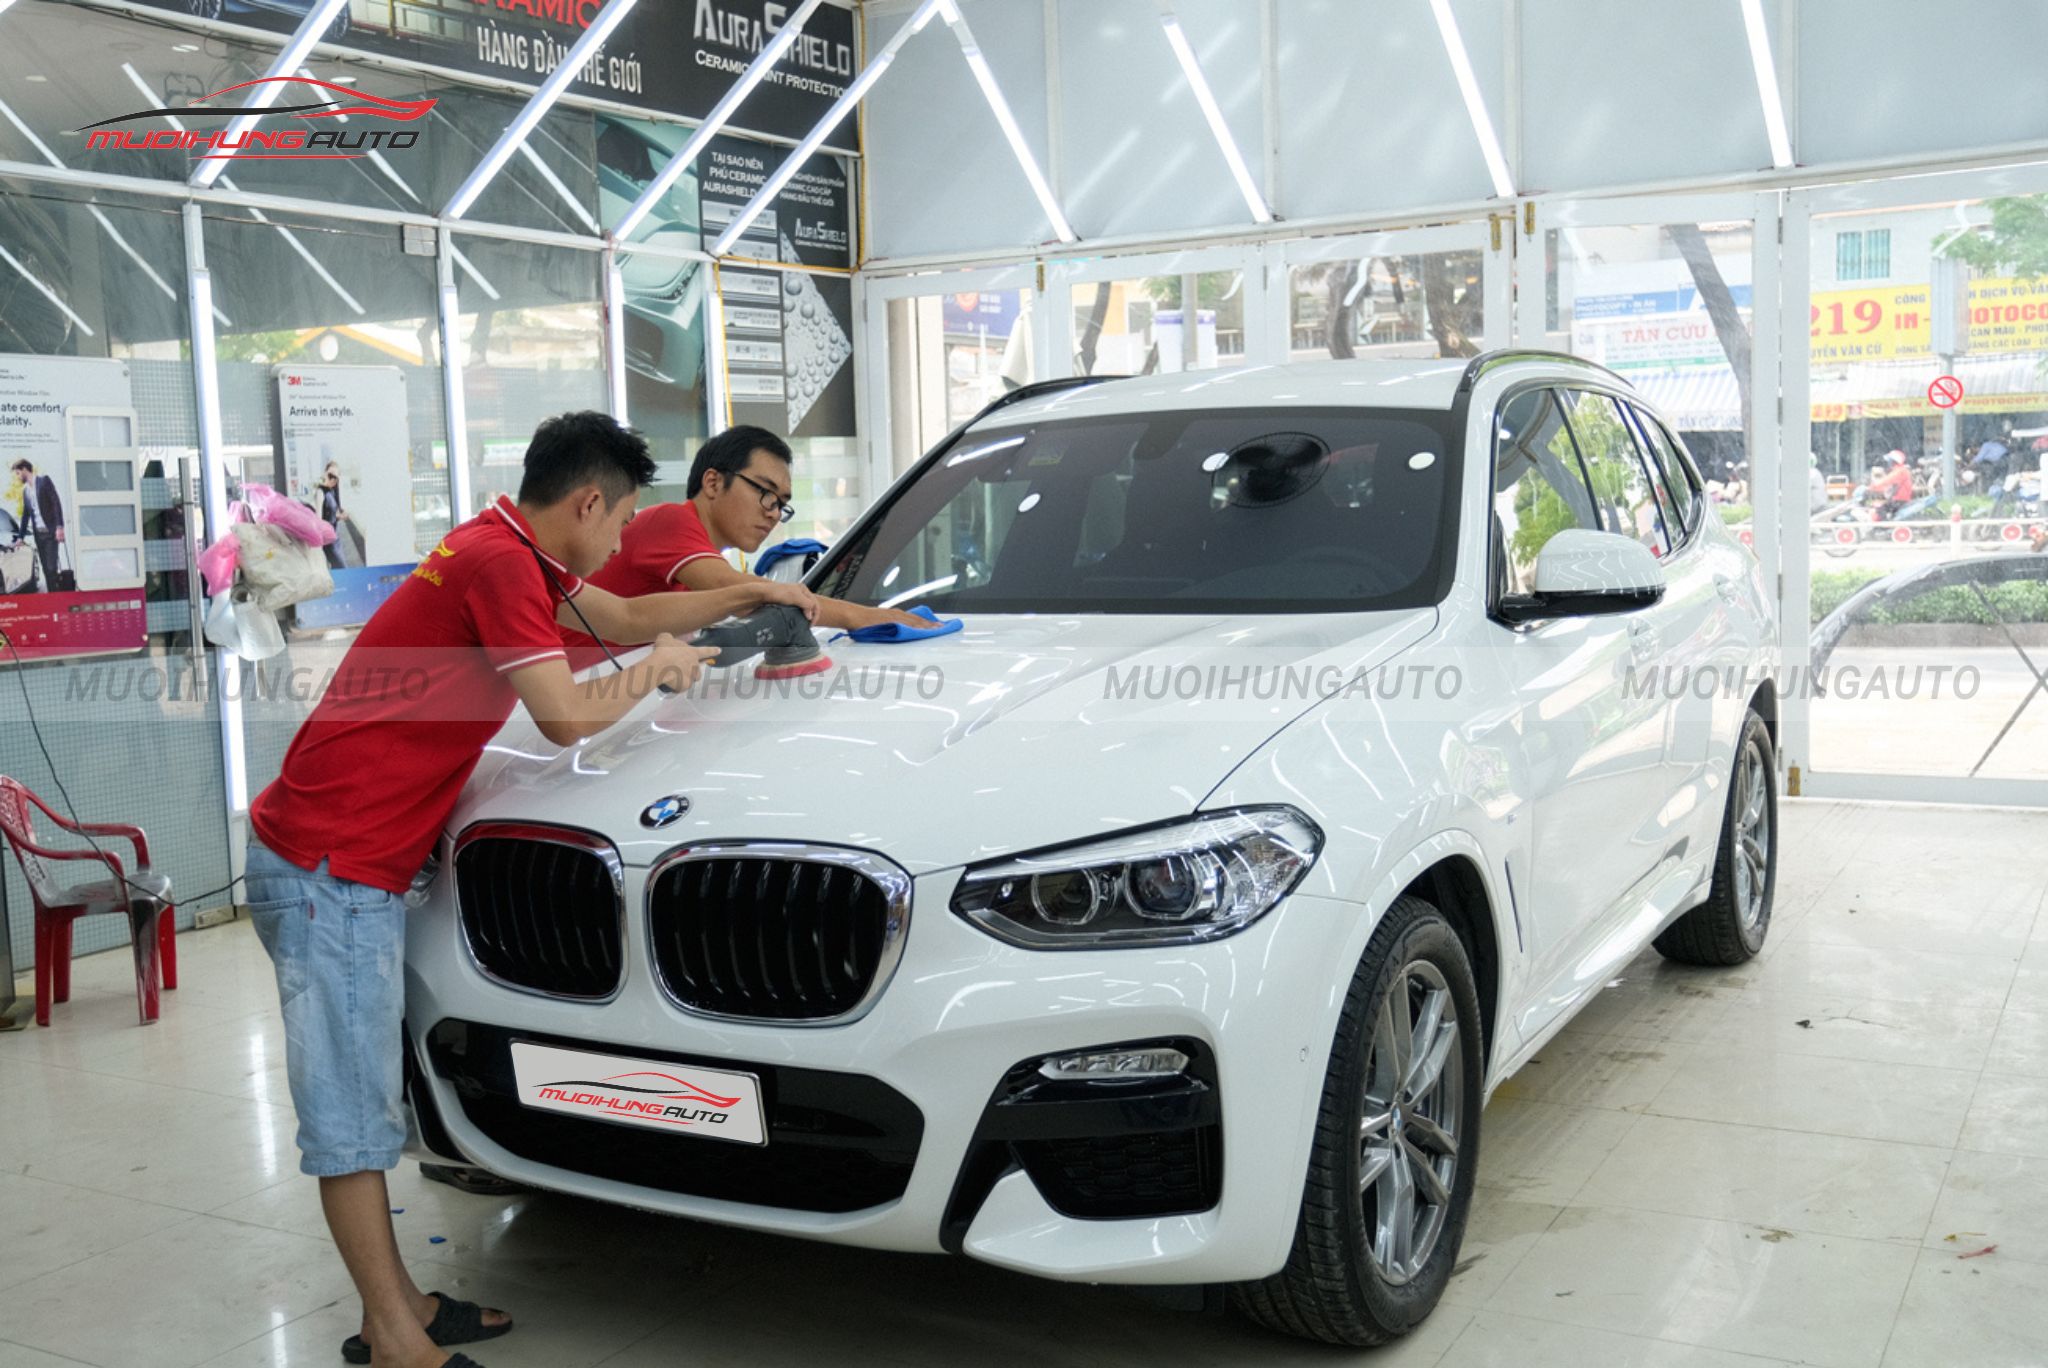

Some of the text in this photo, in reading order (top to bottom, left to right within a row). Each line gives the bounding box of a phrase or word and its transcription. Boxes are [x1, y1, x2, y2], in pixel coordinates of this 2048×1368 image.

[477, 19, 528, 70] HÀNG
[576, 44, 606, 87] HẾ
[609, 52, 642, 94] GIỚI
[695, 50, 750, 75] CERAMIC
[785, 74, 845, 98] PROTECTIO
[729, 170, 767, 185] CERAMIC
[287, 375, 302, 387] 3M
[19, 402, 61, 414] comfort
[289, 405, 354, 419] Arrive in style.
